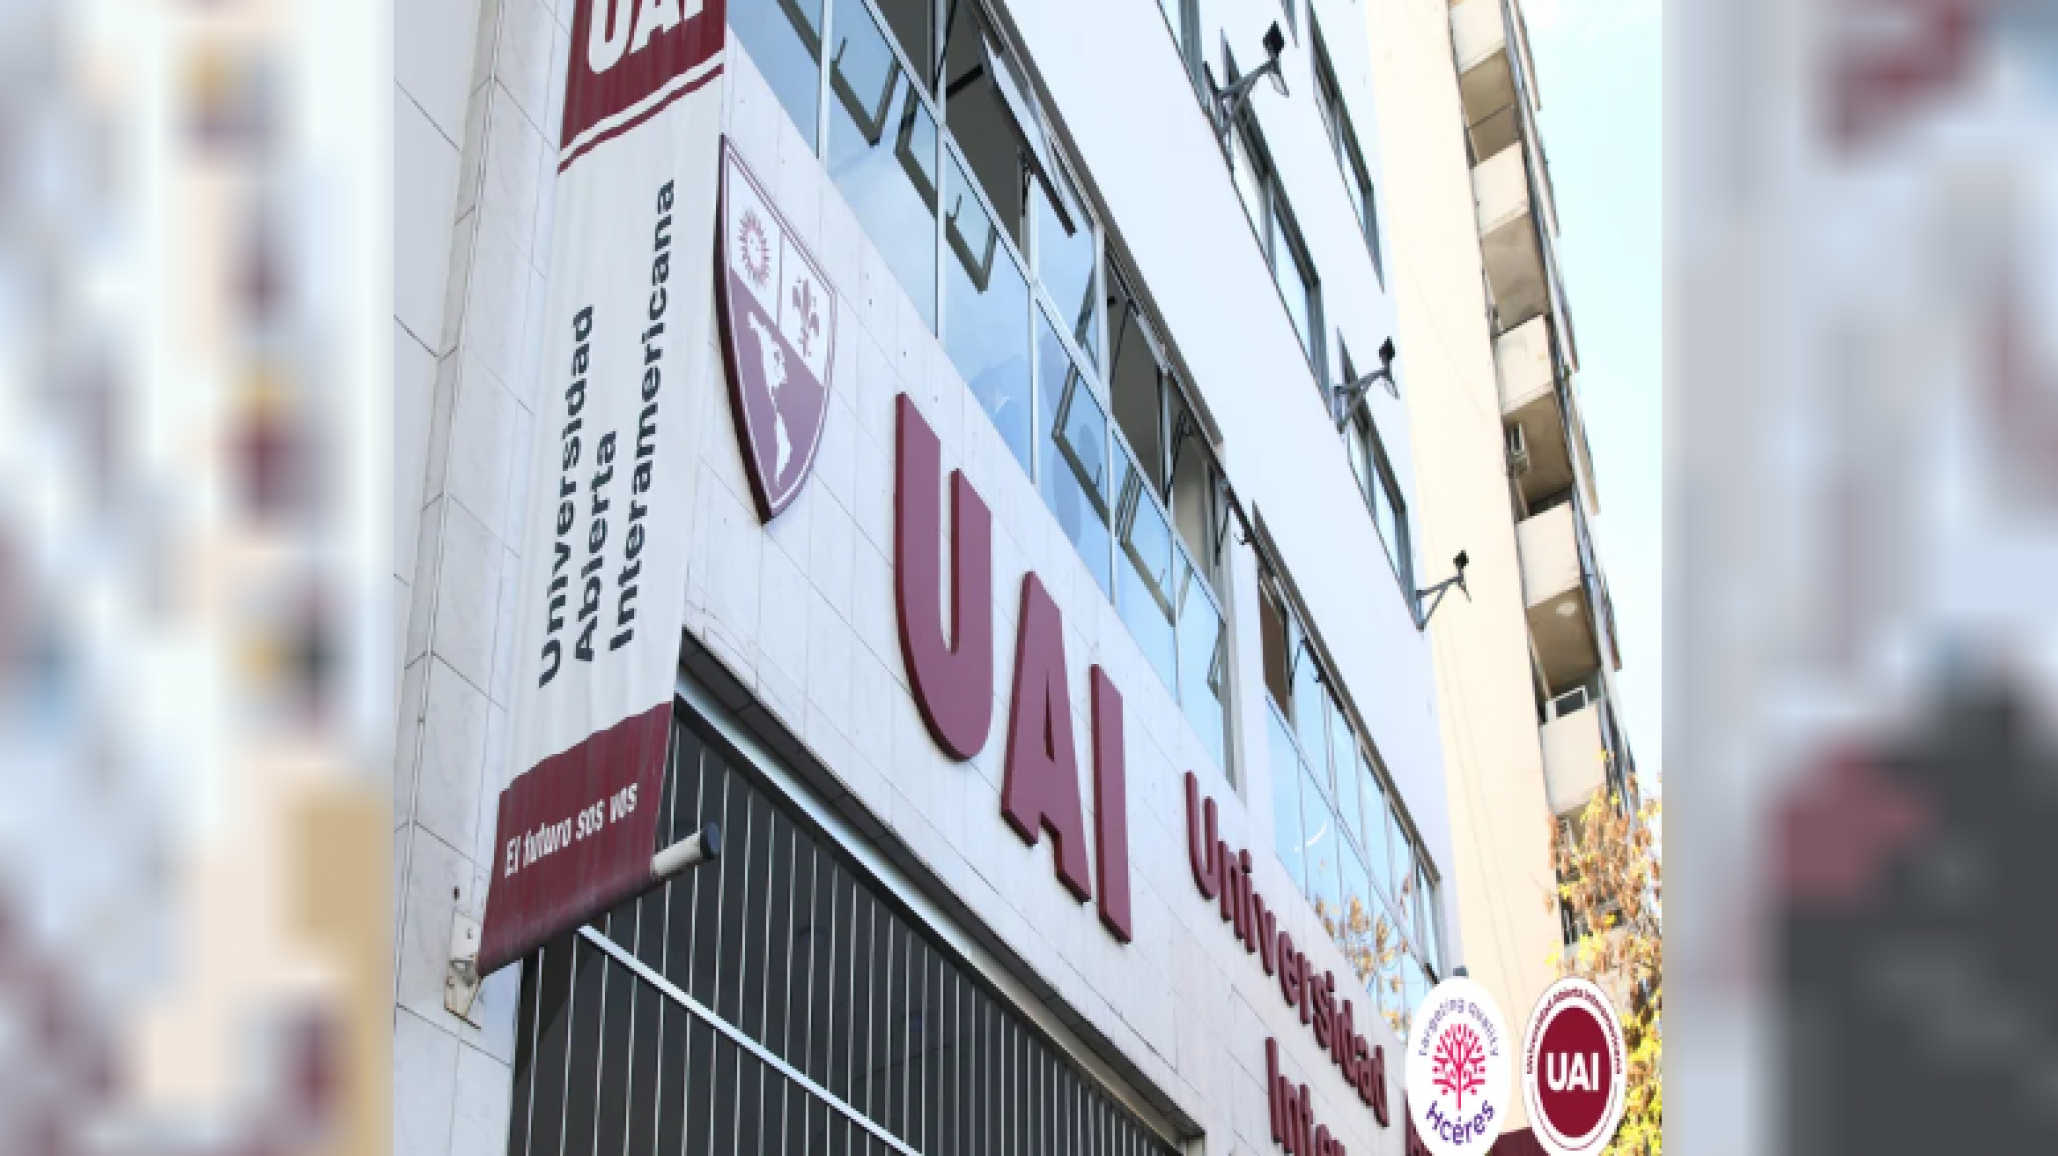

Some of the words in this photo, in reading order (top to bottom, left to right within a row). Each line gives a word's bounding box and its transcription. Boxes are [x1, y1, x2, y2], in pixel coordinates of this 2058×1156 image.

[539, 305, 594, 687] Universidad
[575, 430, 617, 662] Abierta
[610, 180, 675, 651] Interamericana
[504, 835, 521, 878] El
[575, 798, 606, 841] sos
[609, 782, 638, 823] vos
[894, 391, 1132, 944] UAI
[1185, 770, 1389, 1127] Universidad
